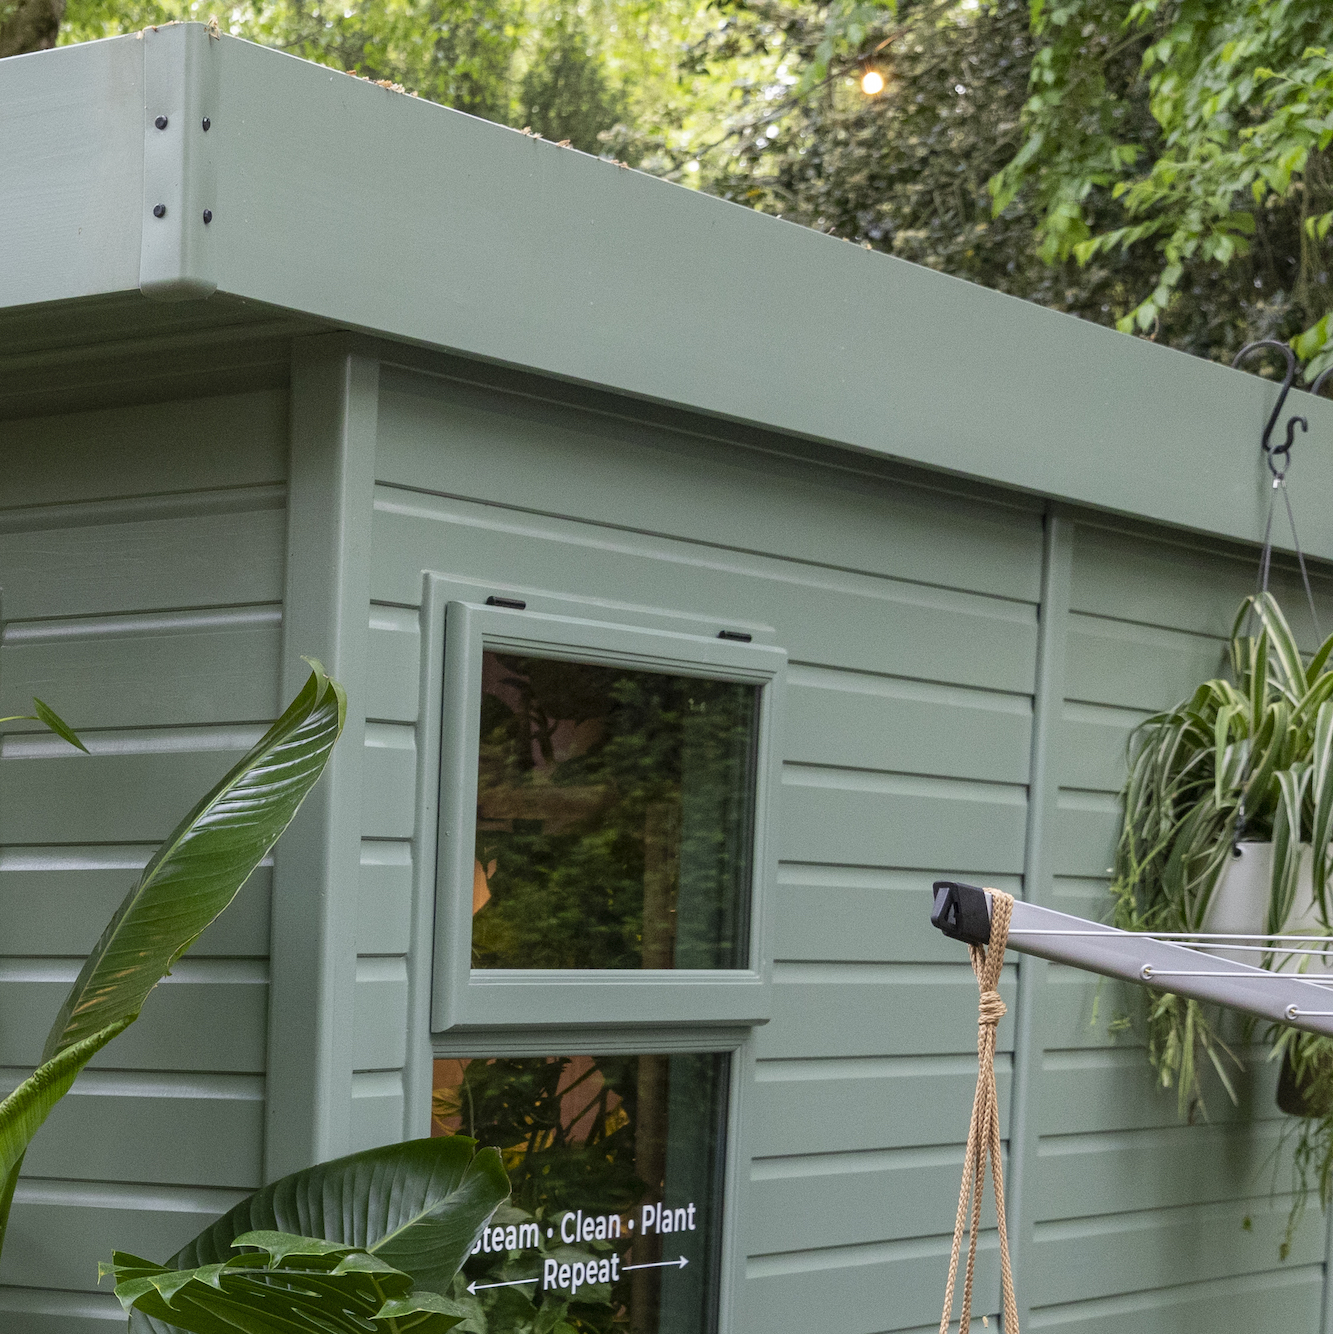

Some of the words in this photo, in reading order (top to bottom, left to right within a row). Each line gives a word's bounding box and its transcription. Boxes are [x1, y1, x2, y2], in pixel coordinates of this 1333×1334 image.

[561, 1209, 621, 1244] Clean
[641, 1202, 696, 1236] Plant
[543, 1252, 620, 1295] Repeat
